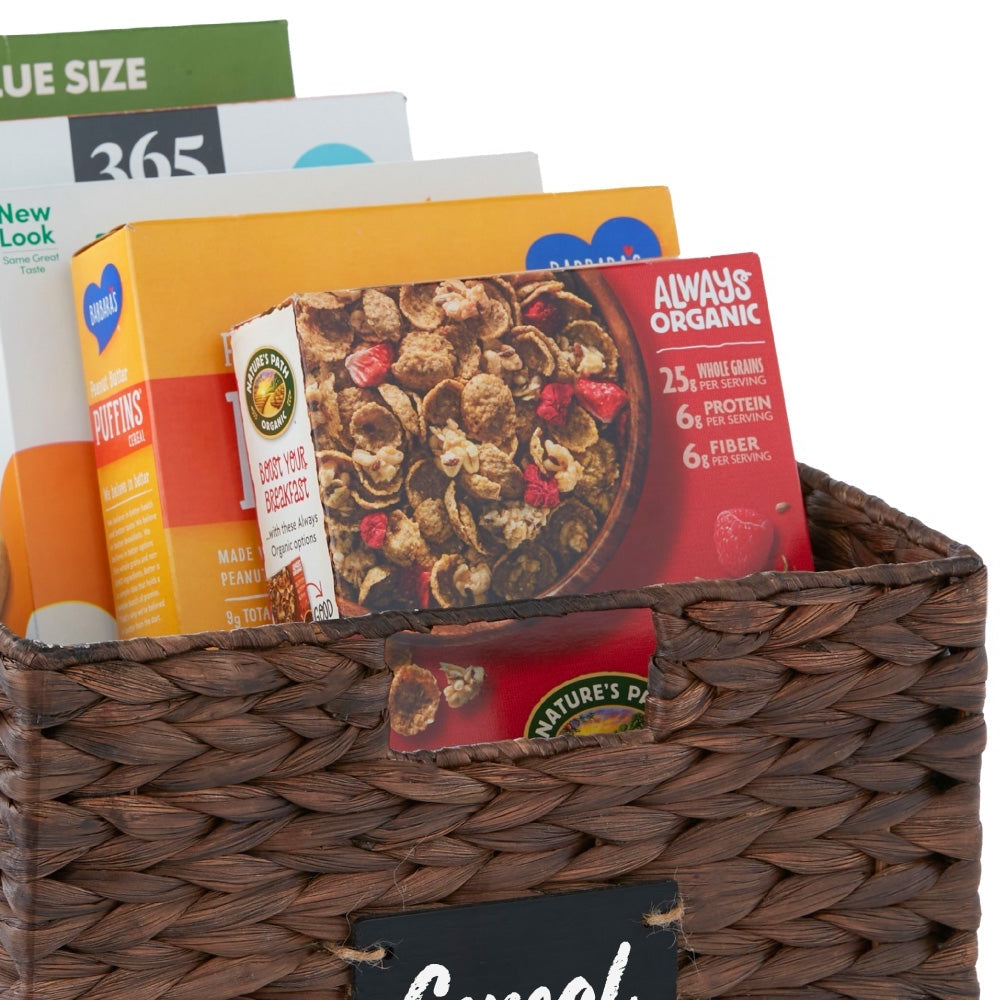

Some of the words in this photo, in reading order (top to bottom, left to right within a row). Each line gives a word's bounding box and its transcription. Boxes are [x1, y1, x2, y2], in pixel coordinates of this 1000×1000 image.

[64, 57, 147, 94] SIZE
[90, 130, 209, 180] 365
[0, 224, 55, 247] Look
[3, 255, 31, 265] Same
[32, 253, 59, 263] Great
[20, 265, 46, 275] Taste
[654, 267, 752, 310] ALWAYS
[650, 303, 761, 333] ORGANIC
[246, 353, 269, 393] NATURE'S
[270, 354, 289, 378] PATH
[697, 361, 729, 379] WHOLE
[731, 357, 764, 375] GRAINS
[659, 366, 698, 393] 25g
[700, 380, 719, 391] PER
[721, 375, 767, 388] SERVING
[704, 395, 772, 415] PROTEIN
[93, 389, 143, 446] PUFFINS
[261, 410, 287, 431] ORGANIC
[676, 404, 703, 429] 6g
[706, 415, 725, 426] PER
[728, 411, 773, 425] SERVING
[683, 443, 710, 469] 6g
[710, 436, 760, 454] FIBER
[259, 456, 283, 485] BOOST
[283, 446, 308, 474] YOUR
[712, 455, 729, 466] PER
[731, 451, 772, 465] SERVING
[281, 521, 297, 535] these
[298, 514, 318, 528] Always
[217, 546, 253, 564] MADE
[271, 541, 293, 558] Organic
[293, 533, 317, 551] options
[220, 568, 265, 587] PEANU
[226, 611, 242, 628] 9g
[243, 606, 270, 622] TOTA
[535, 683, 620, 740] NATURE'S
